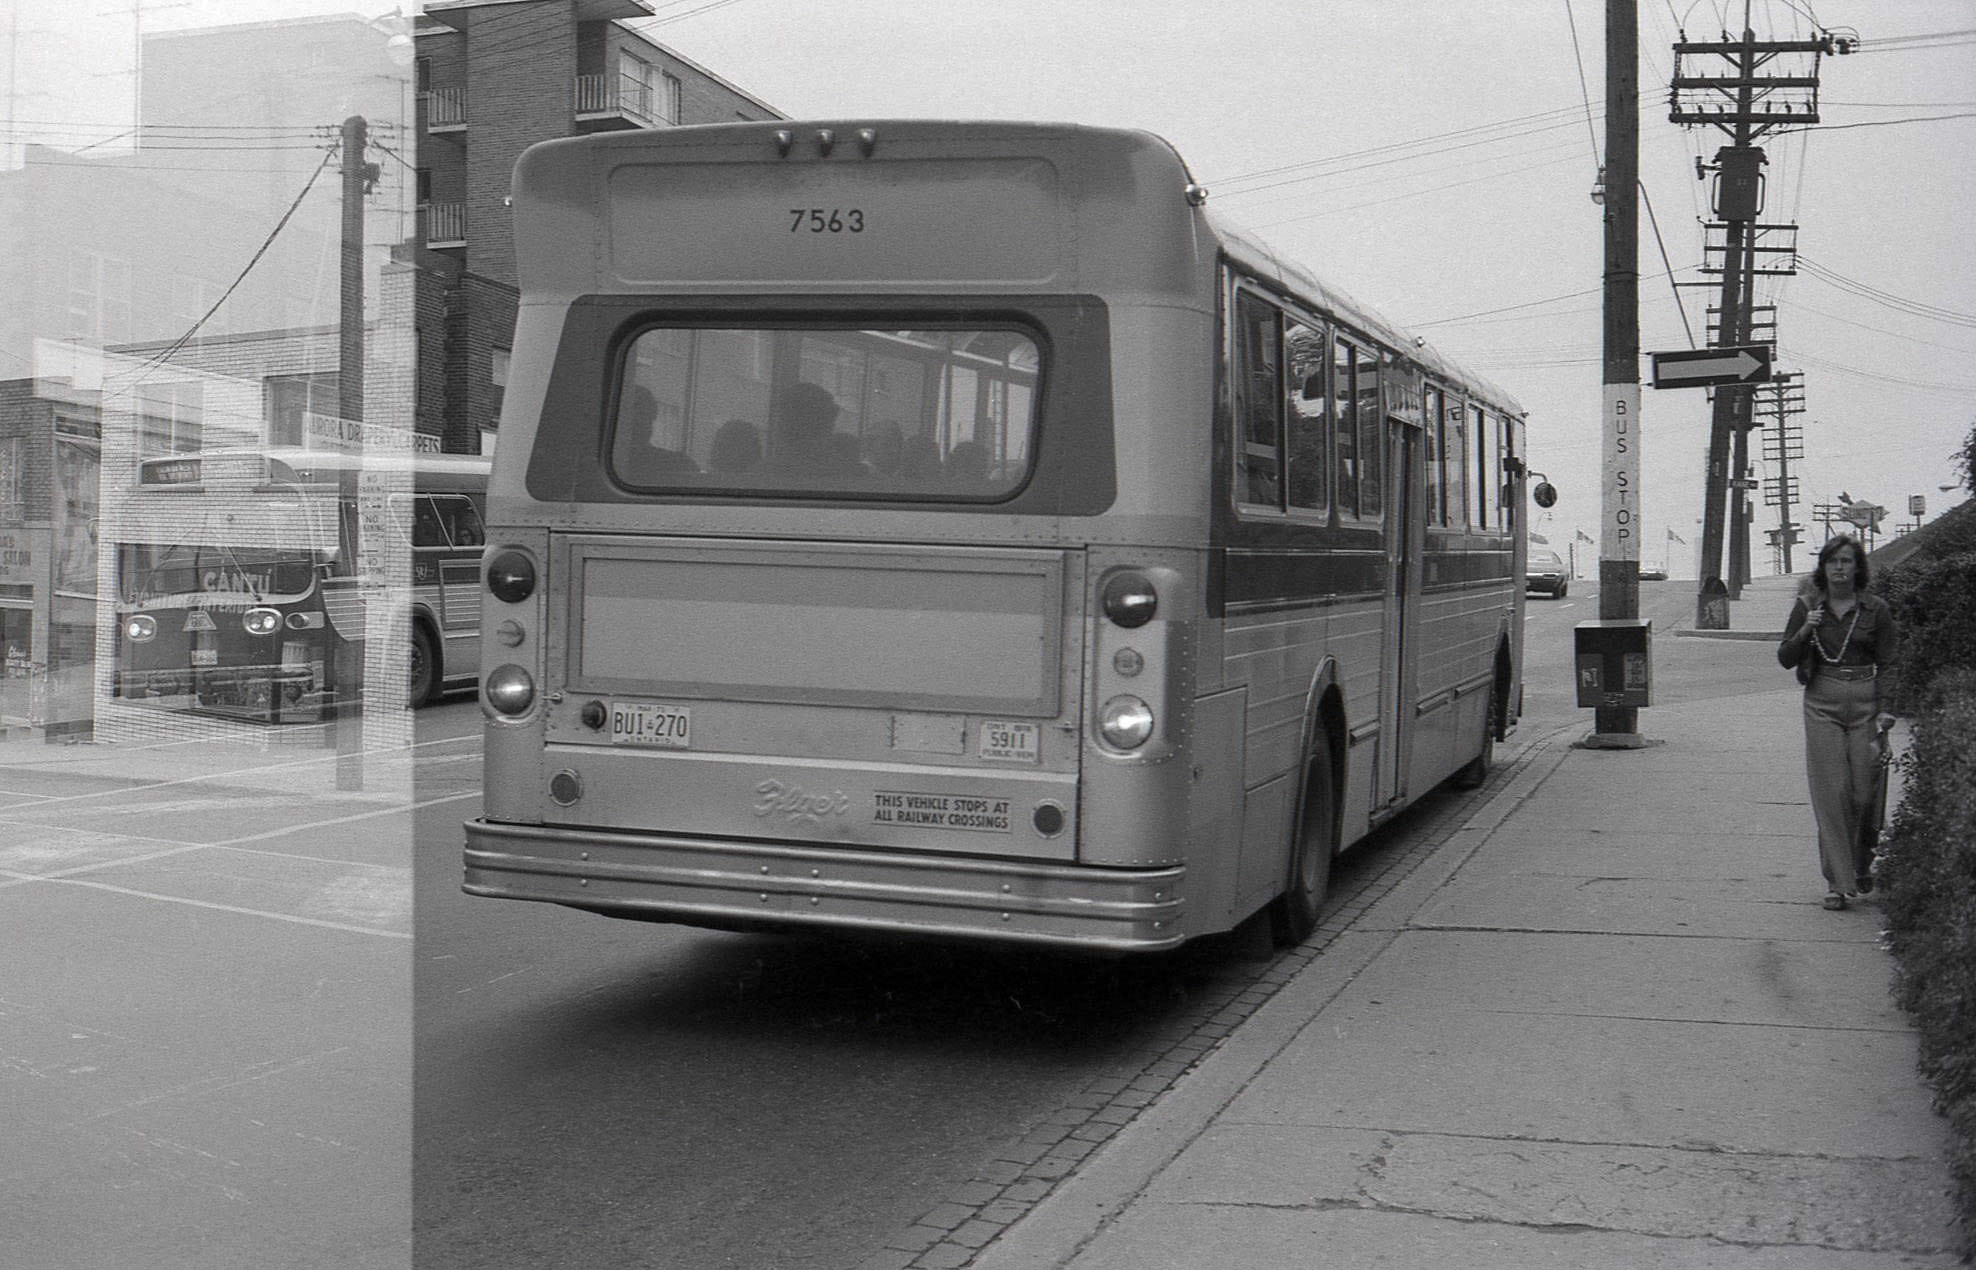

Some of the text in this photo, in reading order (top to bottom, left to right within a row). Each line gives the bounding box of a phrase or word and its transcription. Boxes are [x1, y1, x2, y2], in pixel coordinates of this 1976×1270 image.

[789, 208, 864, 233] 7563
[1615, 400, 1631, 544] BUS STOP
[990, 731, 1025, 749] 5911
[874, 795, 1010, 814] THIS VEHICLE STOPS AT
[874, 809, 1009, 829] ALL RAILWAY CROSSINGS
